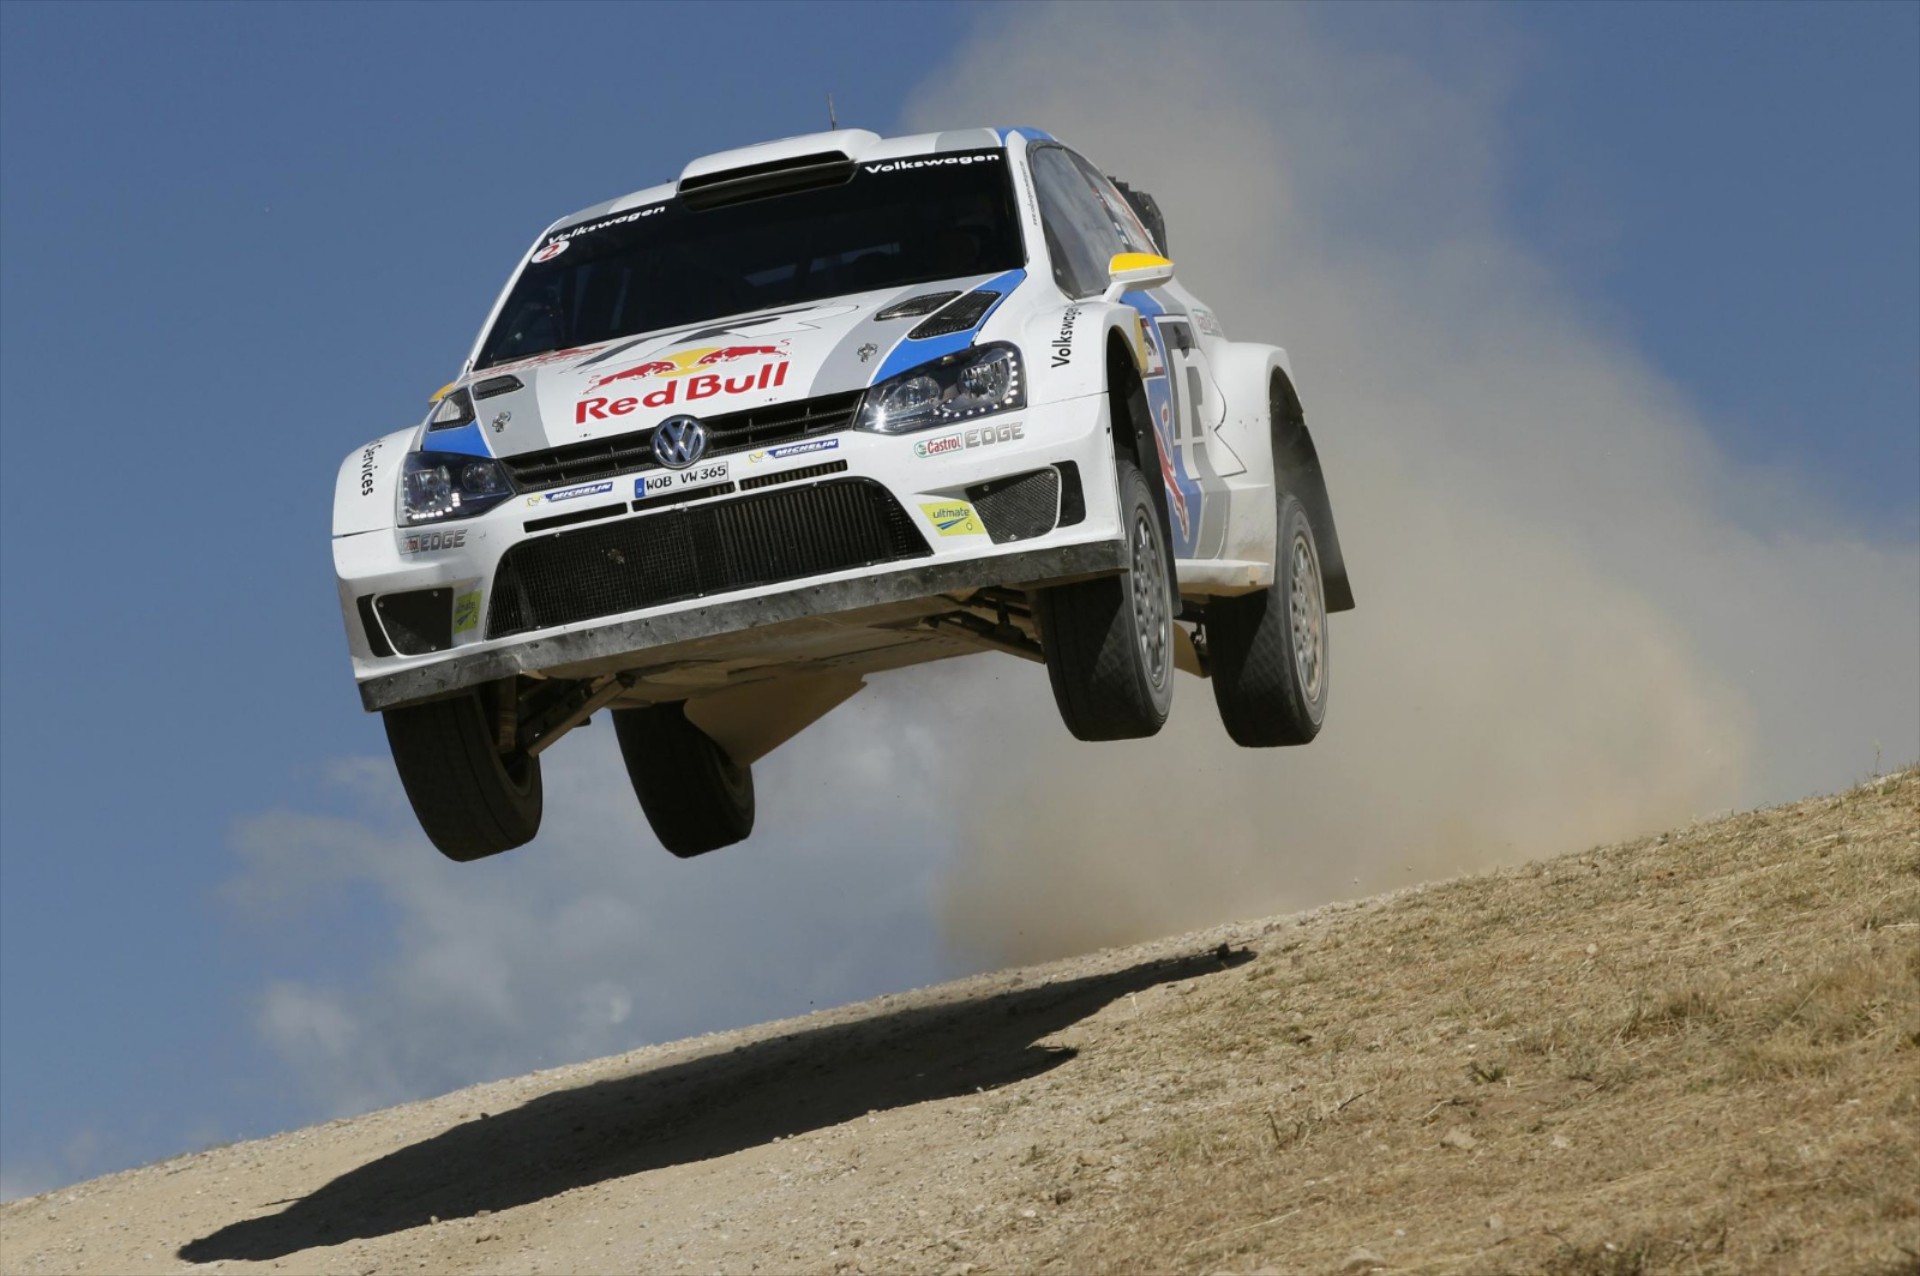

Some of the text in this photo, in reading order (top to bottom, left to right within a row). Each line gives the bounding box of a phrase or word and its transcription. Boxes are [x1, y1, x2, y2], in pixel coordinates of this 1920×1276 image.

[865, 154, 1000, 174] Volkswagen
[548, 205, 666, 243] Volkswagen
[539, 244, 560, 261] 2
[575, 361, 790, 424] Red Bull
[775, 439, 838, 457] MICHELIN
[927, 421, 1025, 454] Castrol EDGE
[646, 465, 726, 491] WOB VW 365
[551, 482, 612, 500] MICHELIN
[932, 507, 970, 519] ultimate
[420, 528, 468, 552] EDGE
